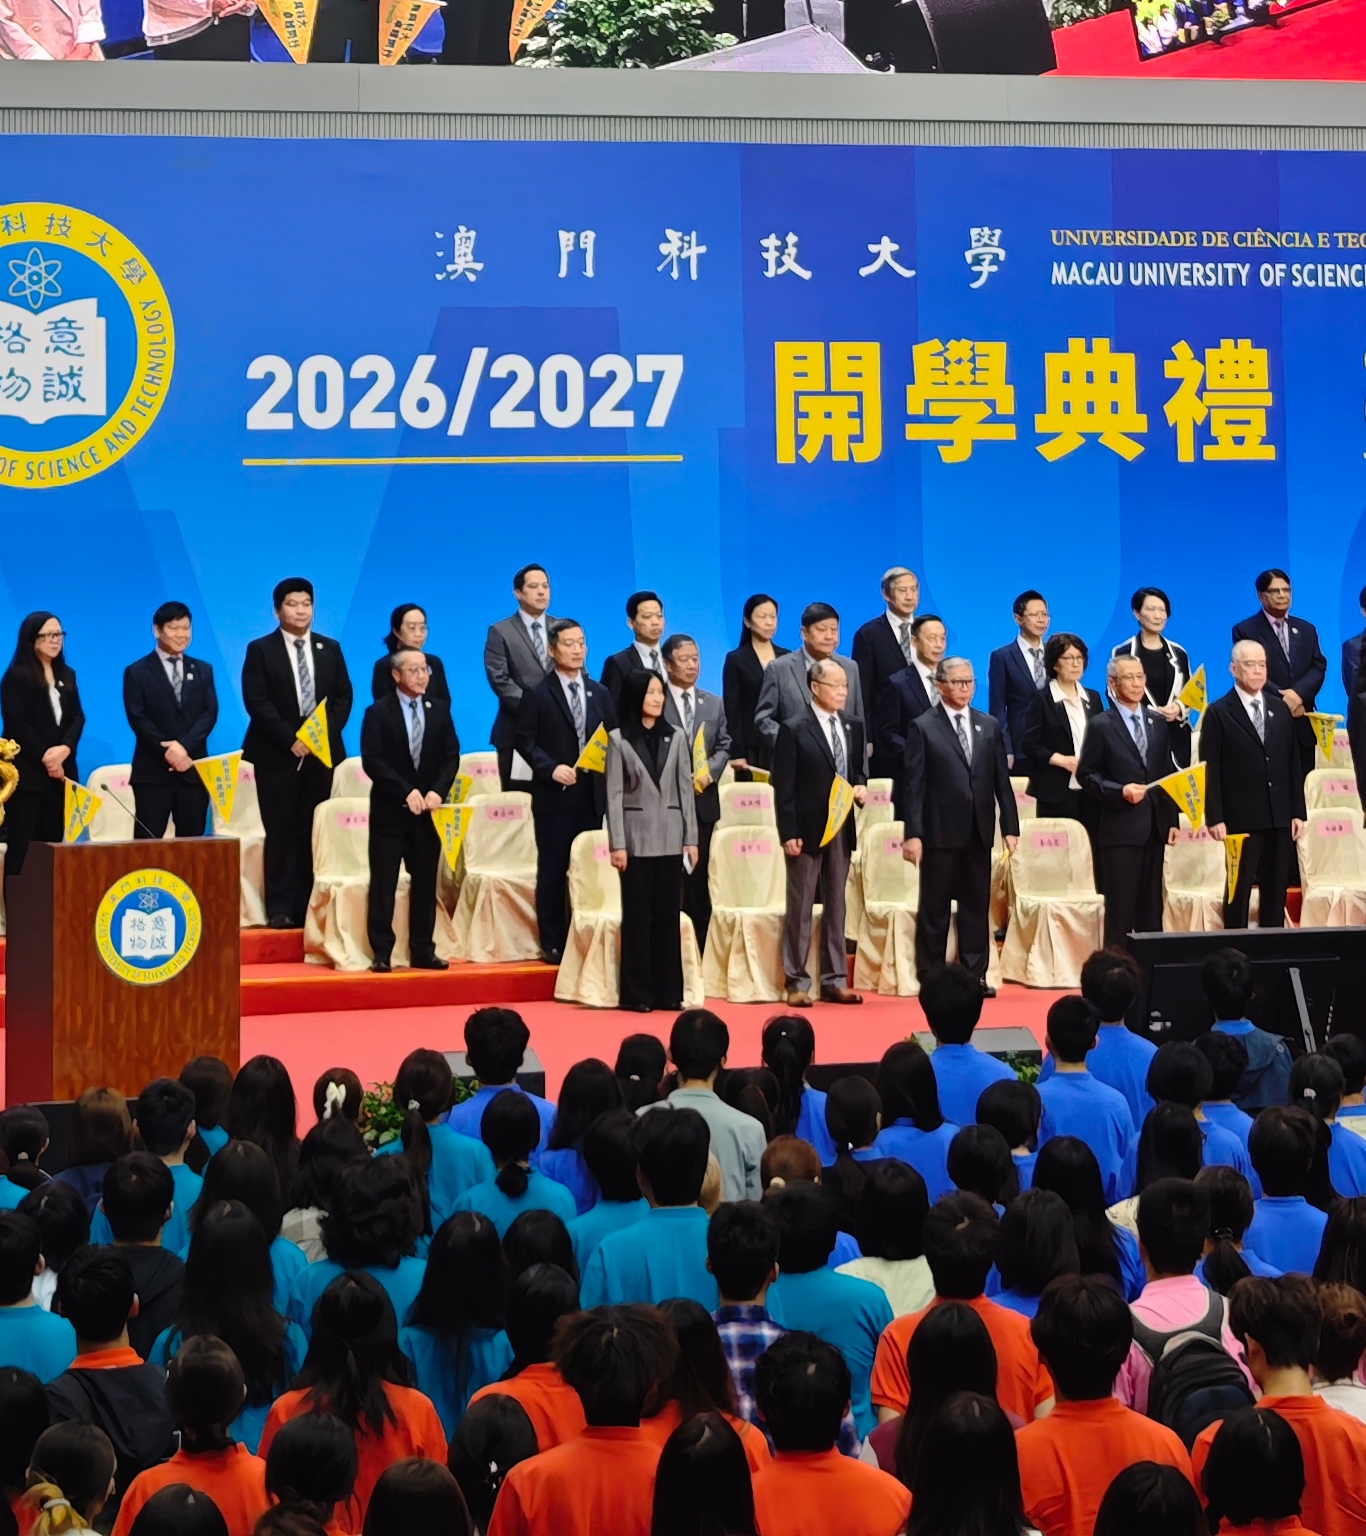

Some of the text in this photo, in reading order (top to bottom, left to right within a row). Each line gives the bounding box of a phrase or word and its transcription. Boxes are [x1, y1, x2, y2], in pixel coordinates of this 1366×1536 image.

[434, 225, 1007, 289] 澳門科技大學
[1051, 229, 1198, 247] UNIVERSIDADE
[1202, 231, 1230, 248] DE
[1233, 227, 1314, 249] CIÊNCIA
[1318, 232, 1331, 248] E
[1051, 261, 1124, 286] MACAU
[1129, 262, 1251, 287] UNIVERSITY
[1259, 262, 1287, 287] OF
[25, 446, 103, 481] SCIENCE
[106, 420, 138, 456] AND
[130, 299, 168, 419] TECHNOLOGY
[245, 347, 684, 437] 2026/2027
[774, 337, 1277, 464] 開學典禮
